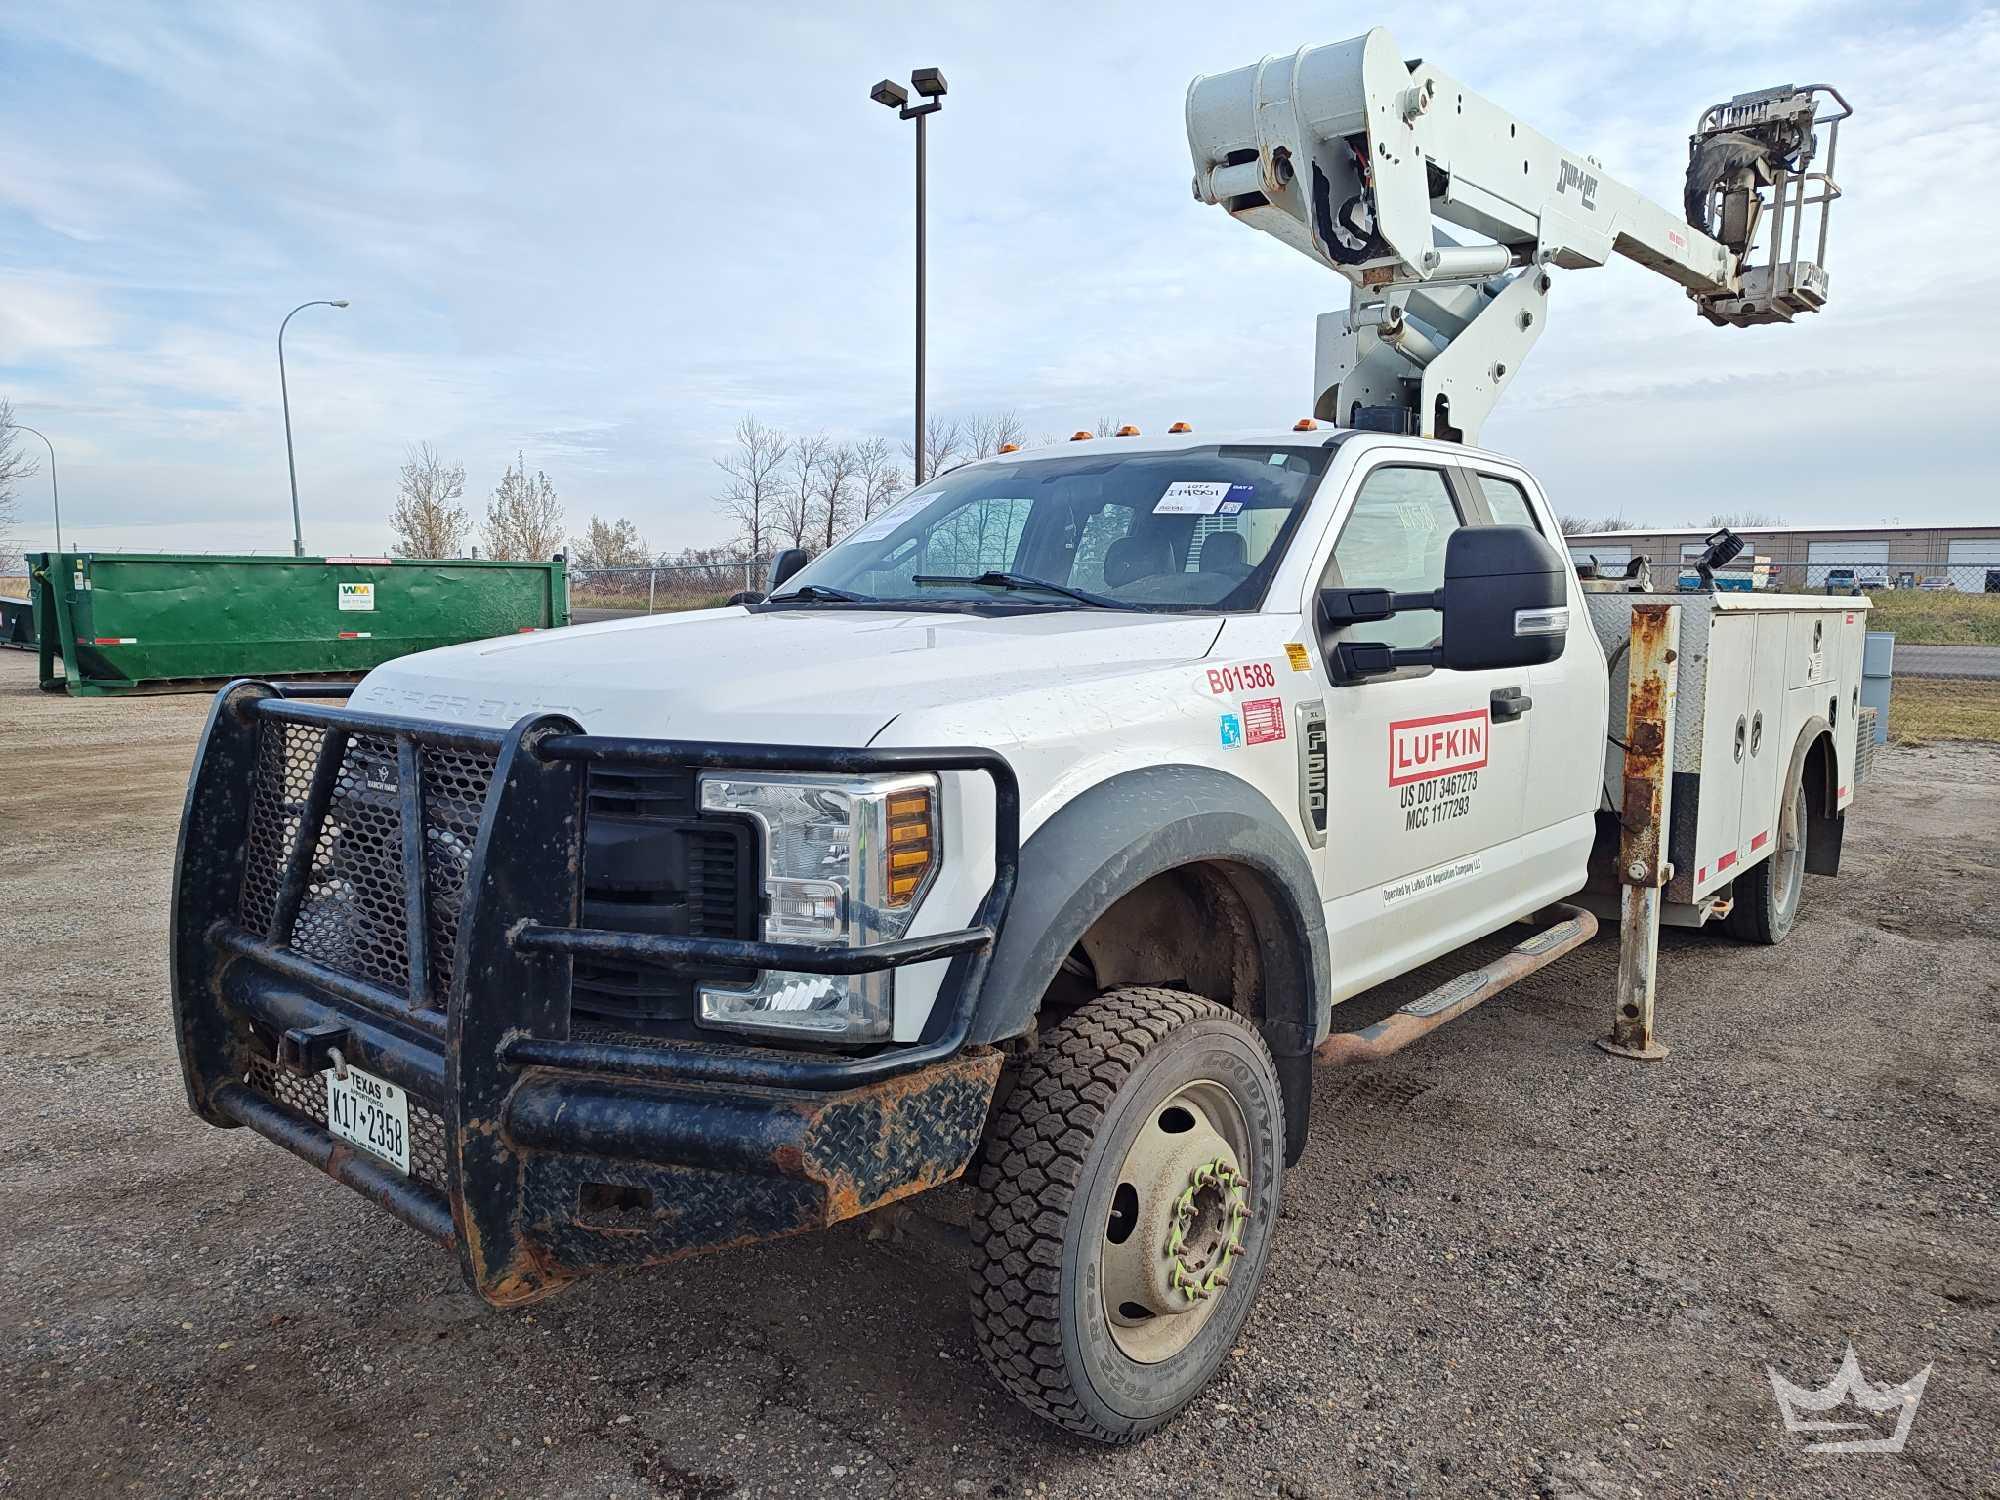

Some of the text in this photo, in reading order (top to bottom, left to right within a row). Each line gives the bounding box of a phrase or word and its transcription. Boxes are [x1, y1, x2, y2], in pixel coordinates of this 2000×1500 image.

[342, 585, 369, 595] WM
[1206, 663, 1275, 694] B01588
[1398, 727, 1480, 768] LUFKIN
[1400, 771, 1478, 808] US DOT 3467273
[1405, 796, 1469, 831] MCC 1177293
[1383, 884, 1404, 902] Operated
[1404, 883, 1411, 895] by
[1411, 879, 1425, 893] Lufkin
[1425, 875, 1432, 886] US
[1455, 862, 1474, 876] Company
[350, 1071, 382, 1100] TEXAS
[367, 1104, 402, 1157] 2358
